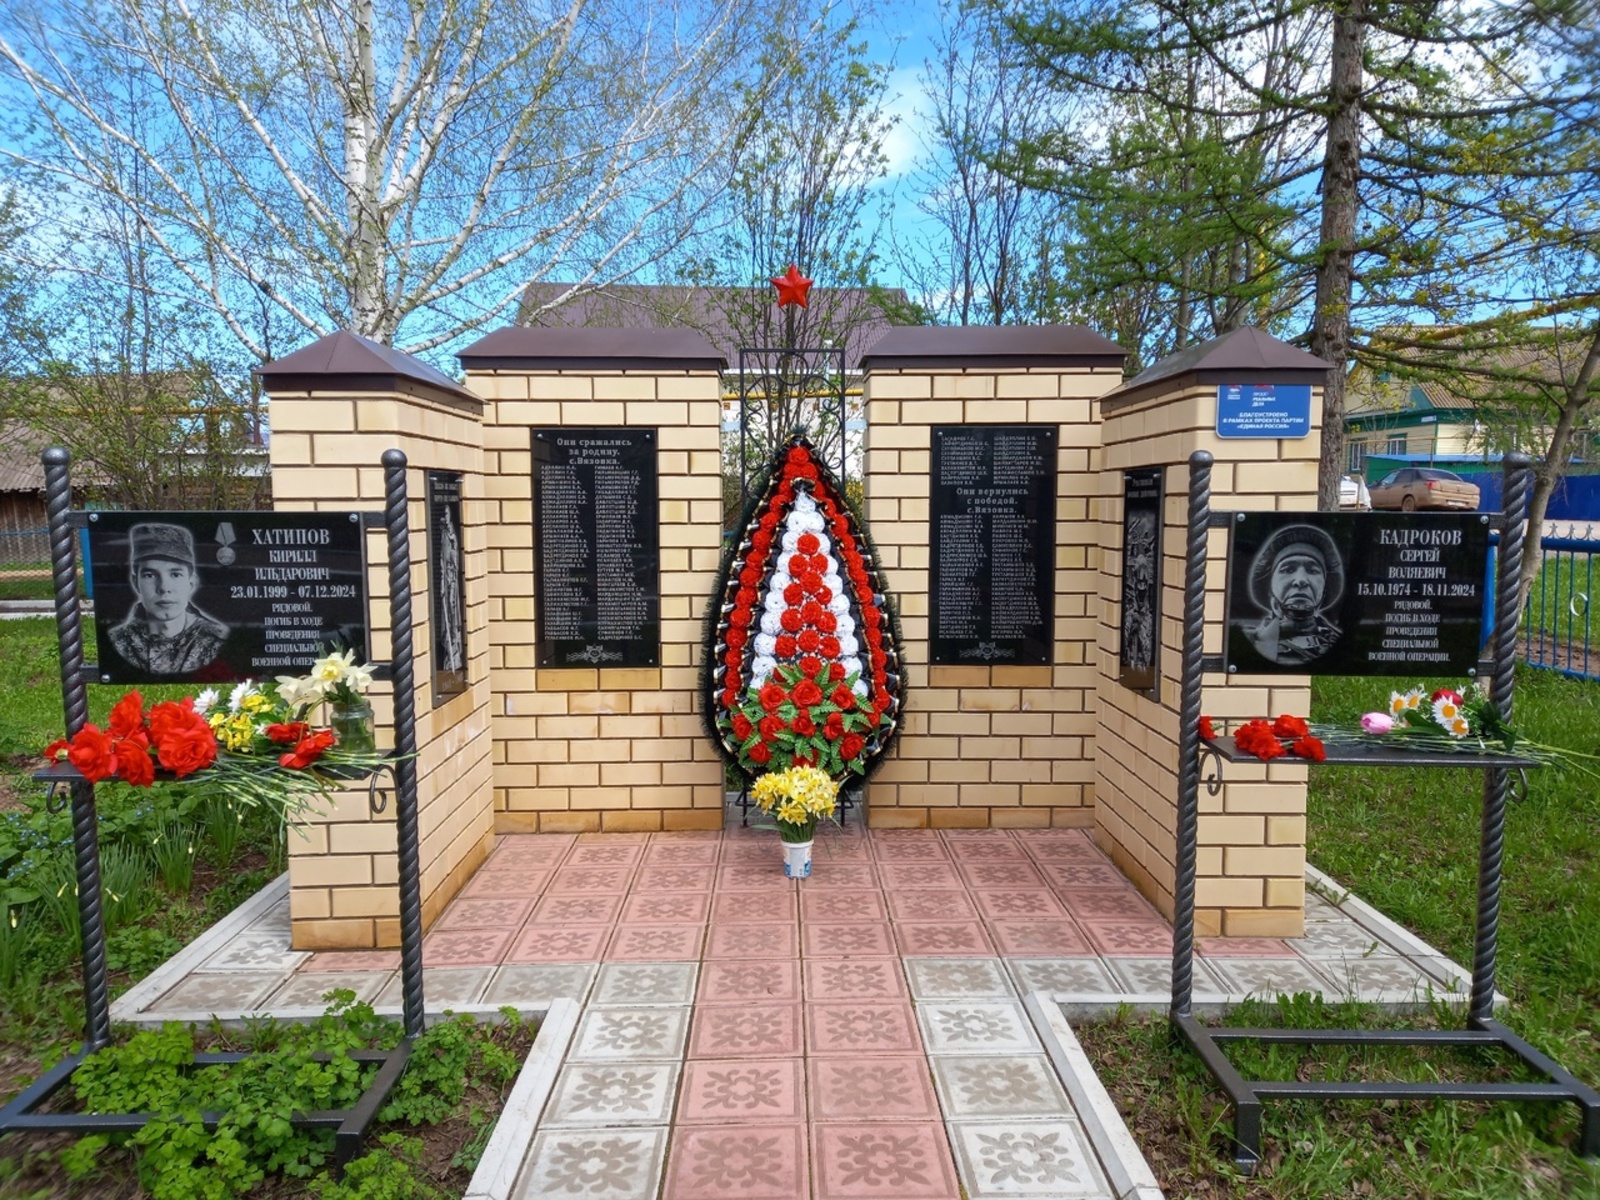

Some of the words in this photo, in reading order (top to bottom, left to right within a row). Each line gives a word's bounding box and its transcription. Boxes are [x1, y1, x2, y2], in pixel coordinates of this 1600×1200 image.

[557, 438, 576, 446] Они
[578, 439, 632, 447] сражались
[582, 448, 620, 457] родину.
[569, 457, 620, 465] с.Вязовка.
[956, 487, 975, 496] Они
[978, 488, 1028, 497] вернулись
[974, 497, 1018, 505] победой.
[252, 528, 330, 545] ХАТИПОВ
[1380, 529, 1462, 547] КАДРОКОВ
[269, 550, 317, 563] КИРИЛЛ
[1400, 547, 1440, 562] СЕРГЕЙ
[255, 568, 330, 582] ИЛЬДАРОВИЧ
[1388, 567, 1446, 579] ВОЛЯЕВИЧ
[230, 586, 288, 599] 23.01.1999
[298, 585, 356, 598] 07.12.2024
[1357, 583, 1412, 596] 15.10.1974
[1421, 584, 1475, 596] 18.11.2024
[272, 602, 313, 613] РЯДОВОЙ.
[1394, 599, 1433, 611] РЯДОВОЙ.
[264, 617, 292, 626] ПОГИБ
[293, 617, 300, 625] В
[300, 617, 323, 626] ХОДЕ
[1385, 613, 1411, 622] ПОГИБ
[1412, 613, 1419, 622] В
[1419, 613, 1441, 624] ХОДЕ
[265, 630, 320, 640] ПРОВЕДЕНИЯ
[1385, 626, 1438, 637] ПРОВЕДЕНИЯ
[1382, 638, 1439, 649] СПЕЦИАЛЬНОЙ
[251, 656, 291, 667] ВОЕННОЙ
[1368, 651, 1406, 661] ВОЕННОЙ
[1406, 652, 1451, 663] ОПЕРАЦИИ.
